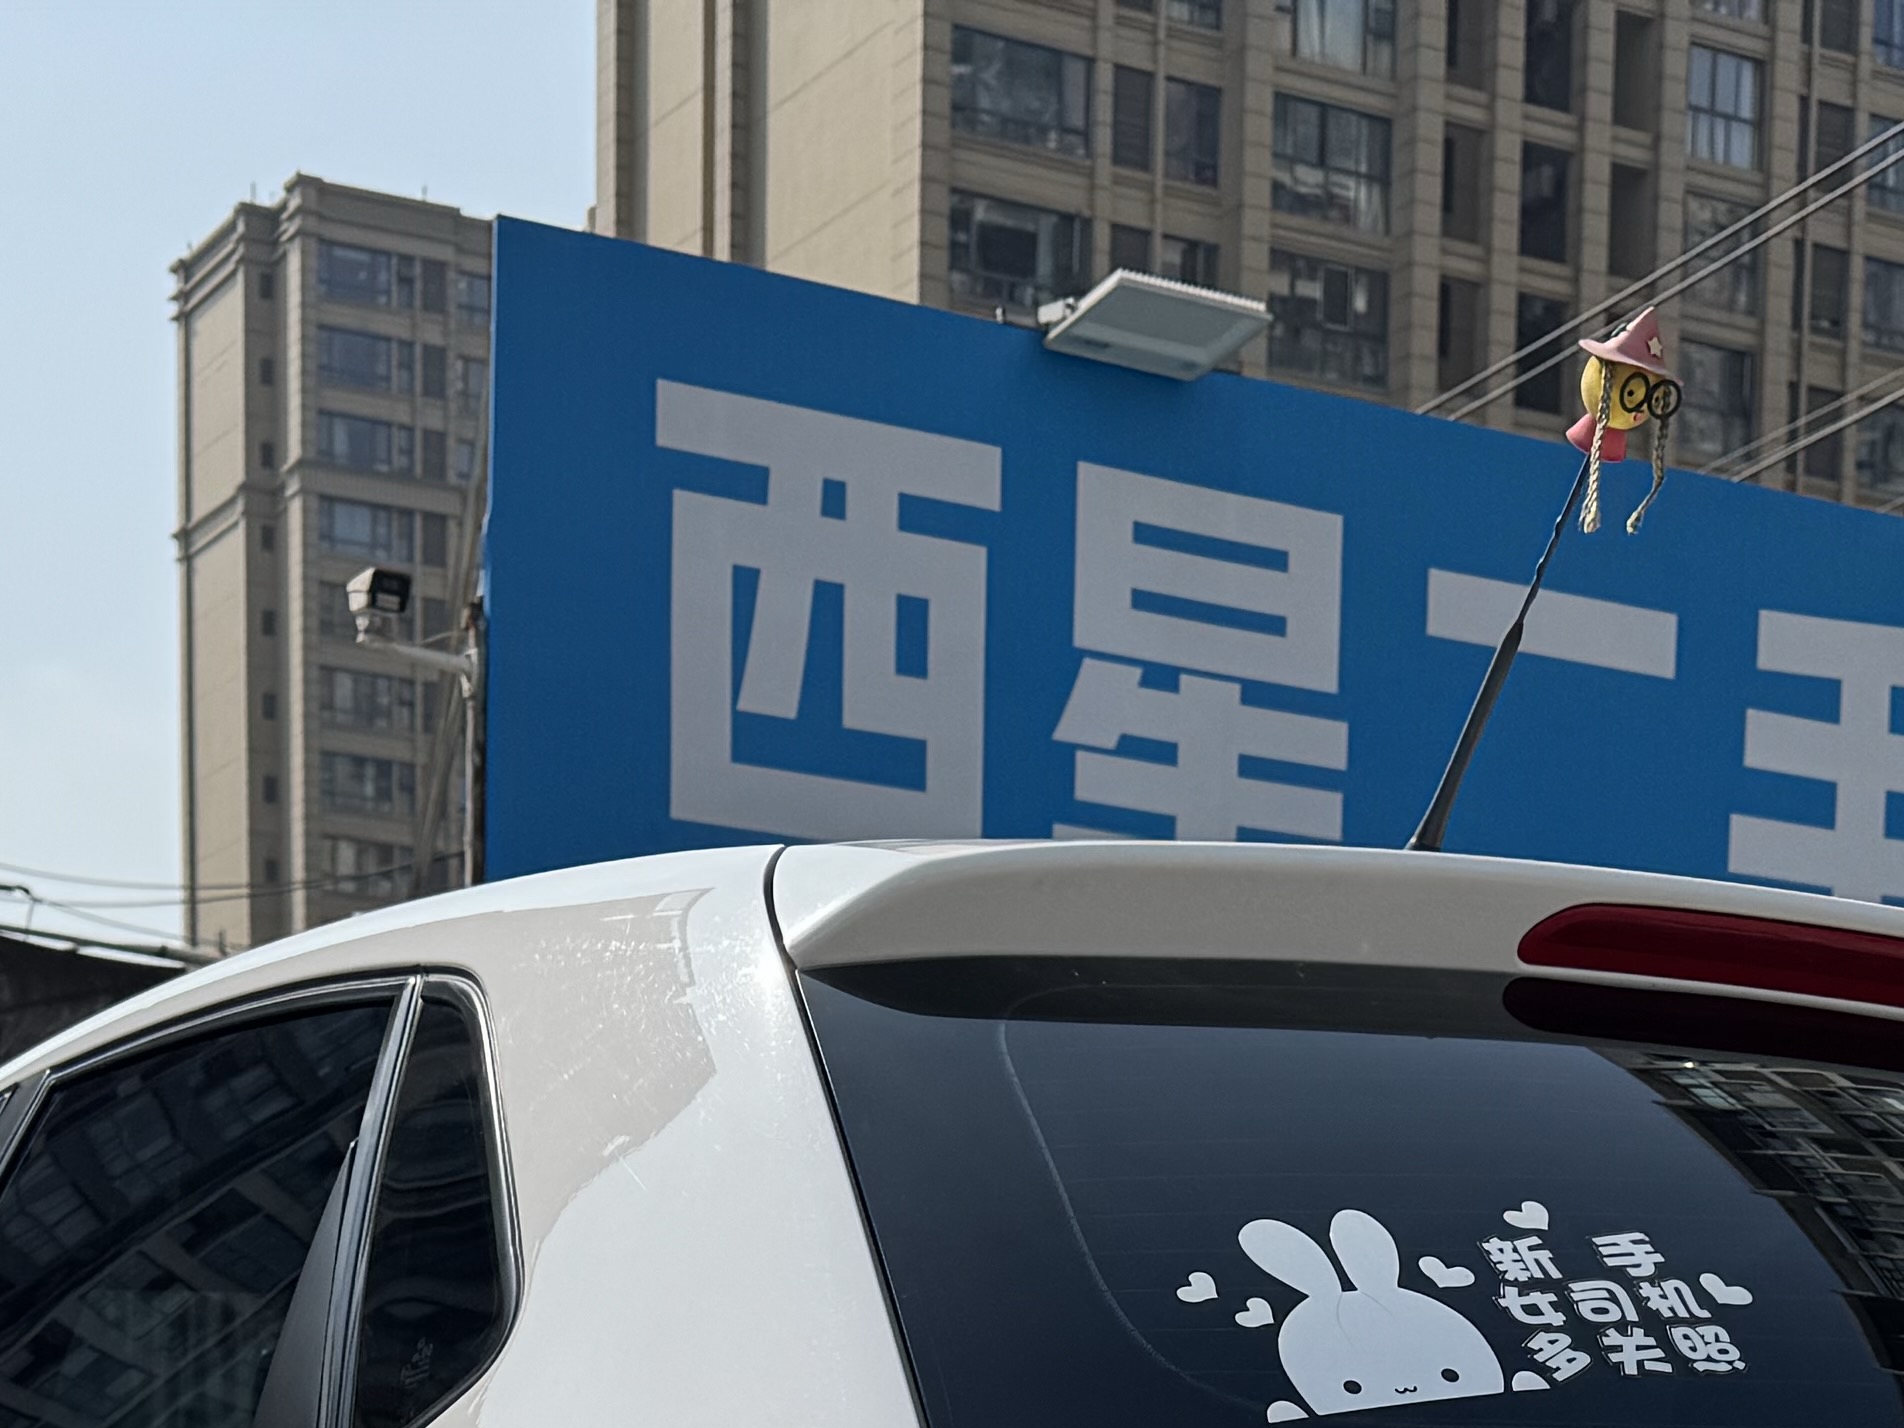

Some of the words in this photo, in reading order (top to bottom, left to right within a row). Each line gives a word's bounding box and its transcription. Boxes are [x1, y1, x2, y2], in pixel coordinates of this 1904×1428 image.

[1496, 1279, 1711, 1327] 女司机
[1524, 1324, 1748, 1382] 多关照
